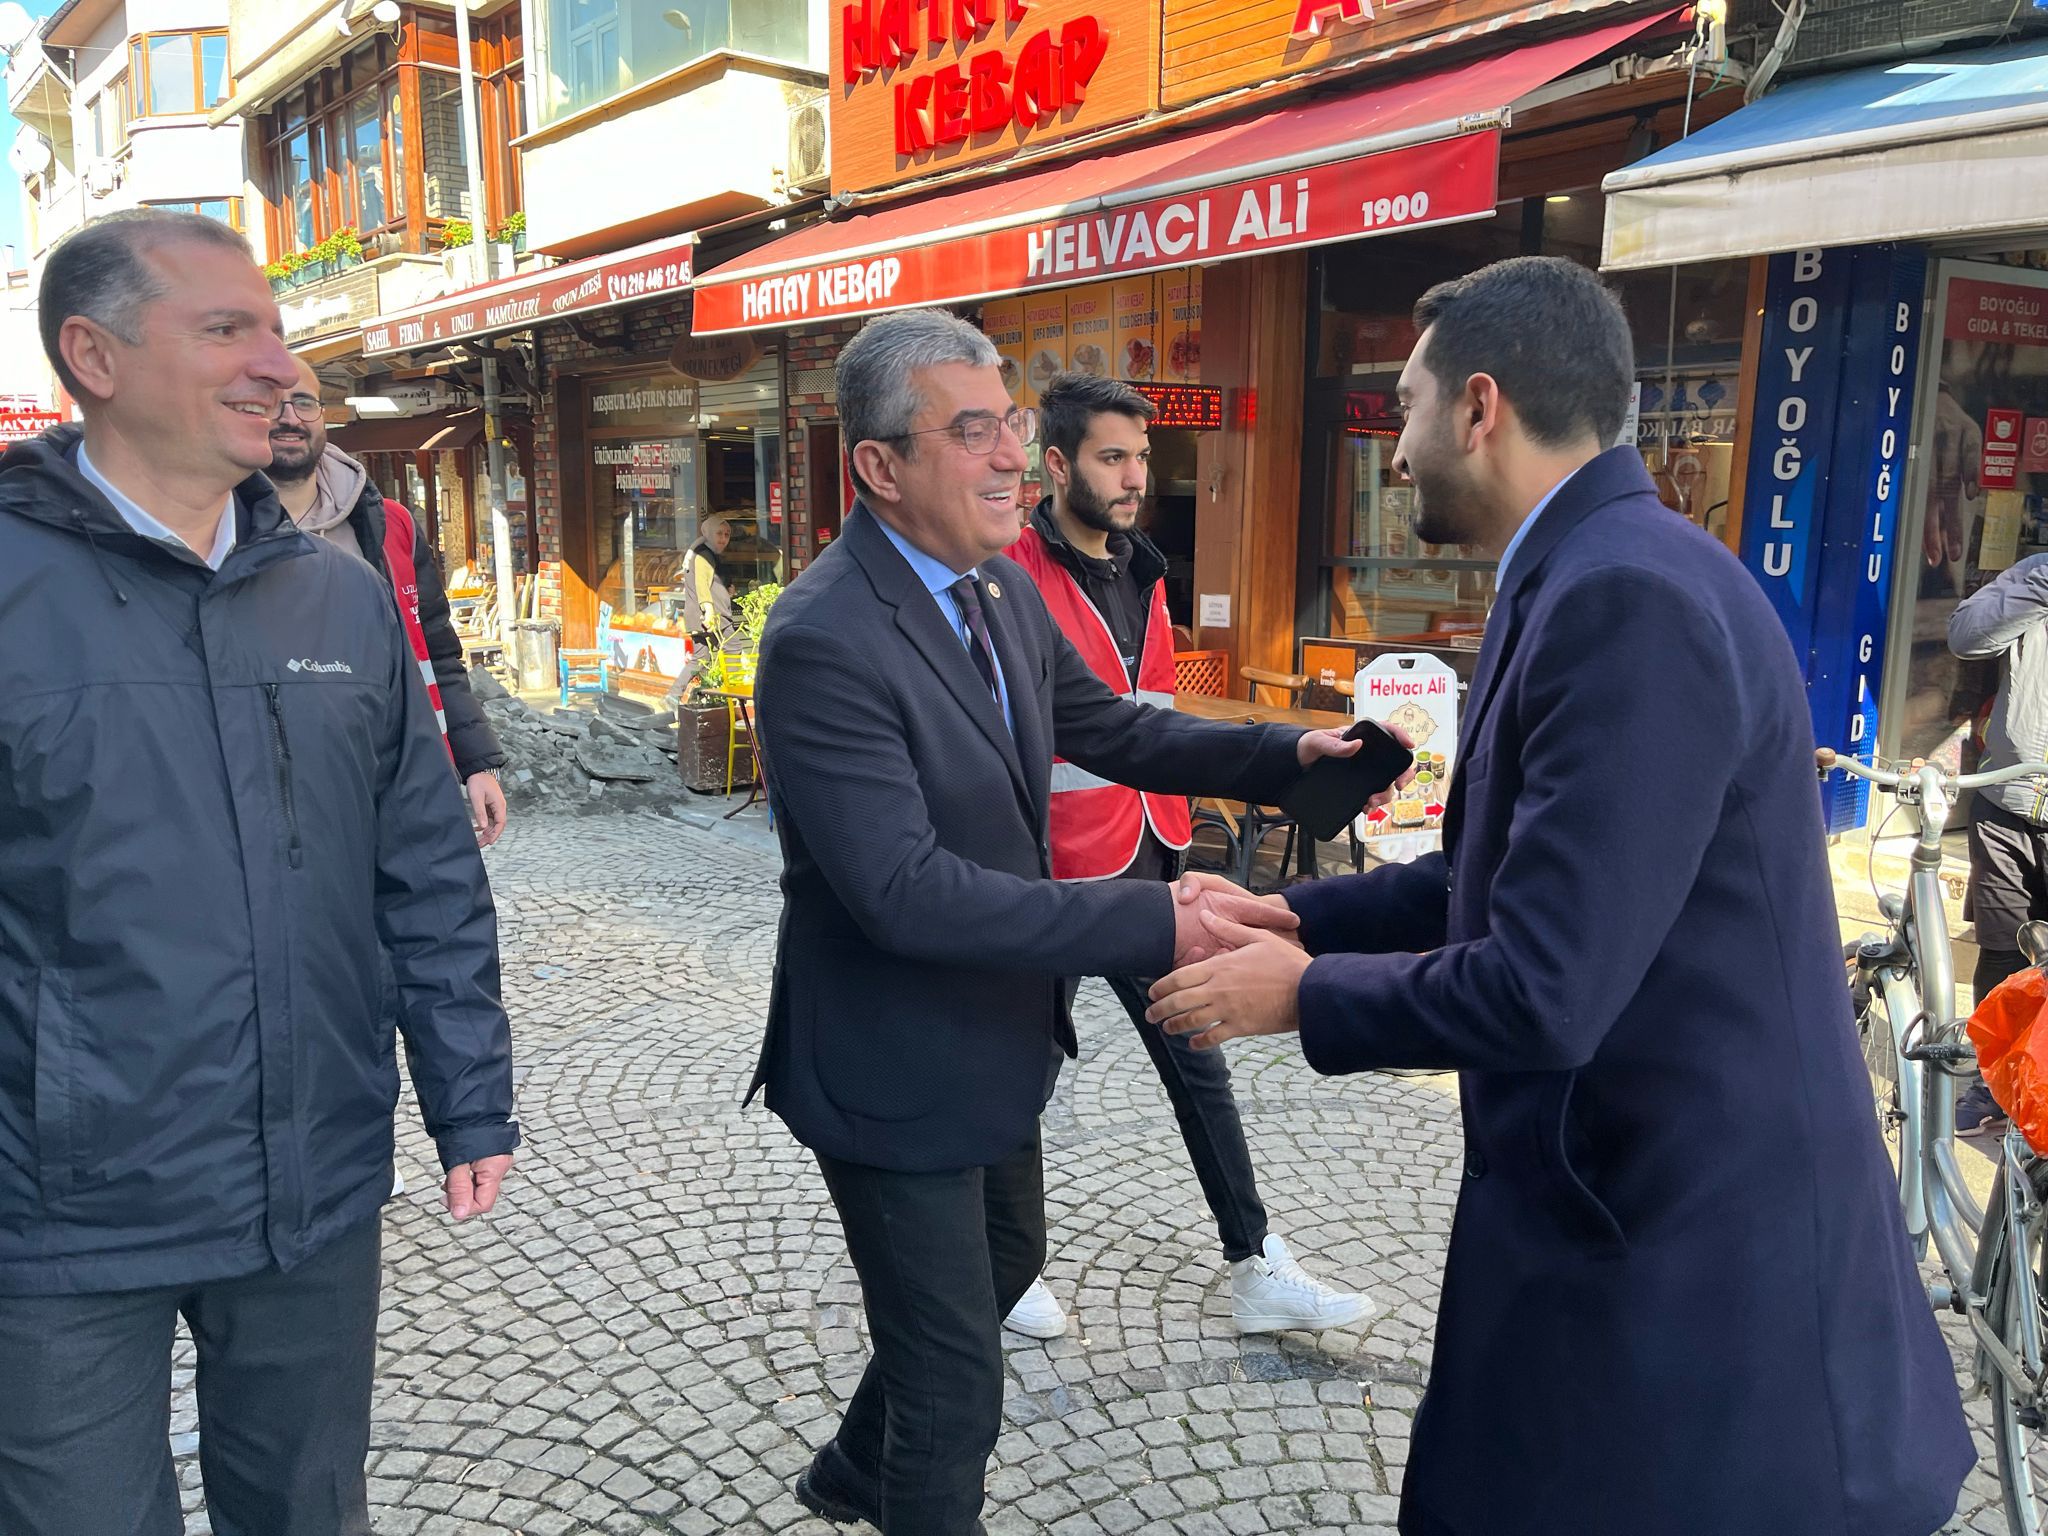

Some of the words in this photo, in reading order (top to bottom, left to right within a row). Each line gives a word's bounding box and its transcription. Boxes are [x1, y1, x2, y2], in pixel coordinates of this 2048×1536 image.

[843, 0, 1029, 86] HATA
[894, 15, 1110, 155] KEBAP
[1027, 199, 1210, 278] HELVACI
[1362, 191, 1429, 227] 1900
[366, 325, 392, 352] SAHİL
[398, 320, 424, 346] FIRIN
[433, 321, 441, 338] &
[451, 312, 474, 334] UNLU
[552, 288, 578, 312] ODUN
[620, 275, 627, 297] 0
[628, 271, 645, 295] 216
[645, 268, 664, 290] 446
[665, 263, 678, 286] 12
[678, 260, 691, 284] 45
[742, 272, 811, 323] HATAY
[817, 257, 900, 305] KEBAP
[1980, 296, 2040, 316] BOYOĞLU
[1967, 318, 1998, 335] GIDA
[2002, 321, 2010, 335] &
[593, 393, 625, 415] MEŞHUR
[625, 392, 641, 413] TAŞ
[642, 389, 666, 408] FIRIN
[667, 384, 693, 407] SİMİT
[1762, 248, 1823, 577] BOYOĞLU
[1867, 301, 1910, 583] BOYOĞLU
[301, 658, 353, 674] Columbia
[1370, 677, 1423, 697] Helvacı
[1427, 676, 1446, 695] Ali
